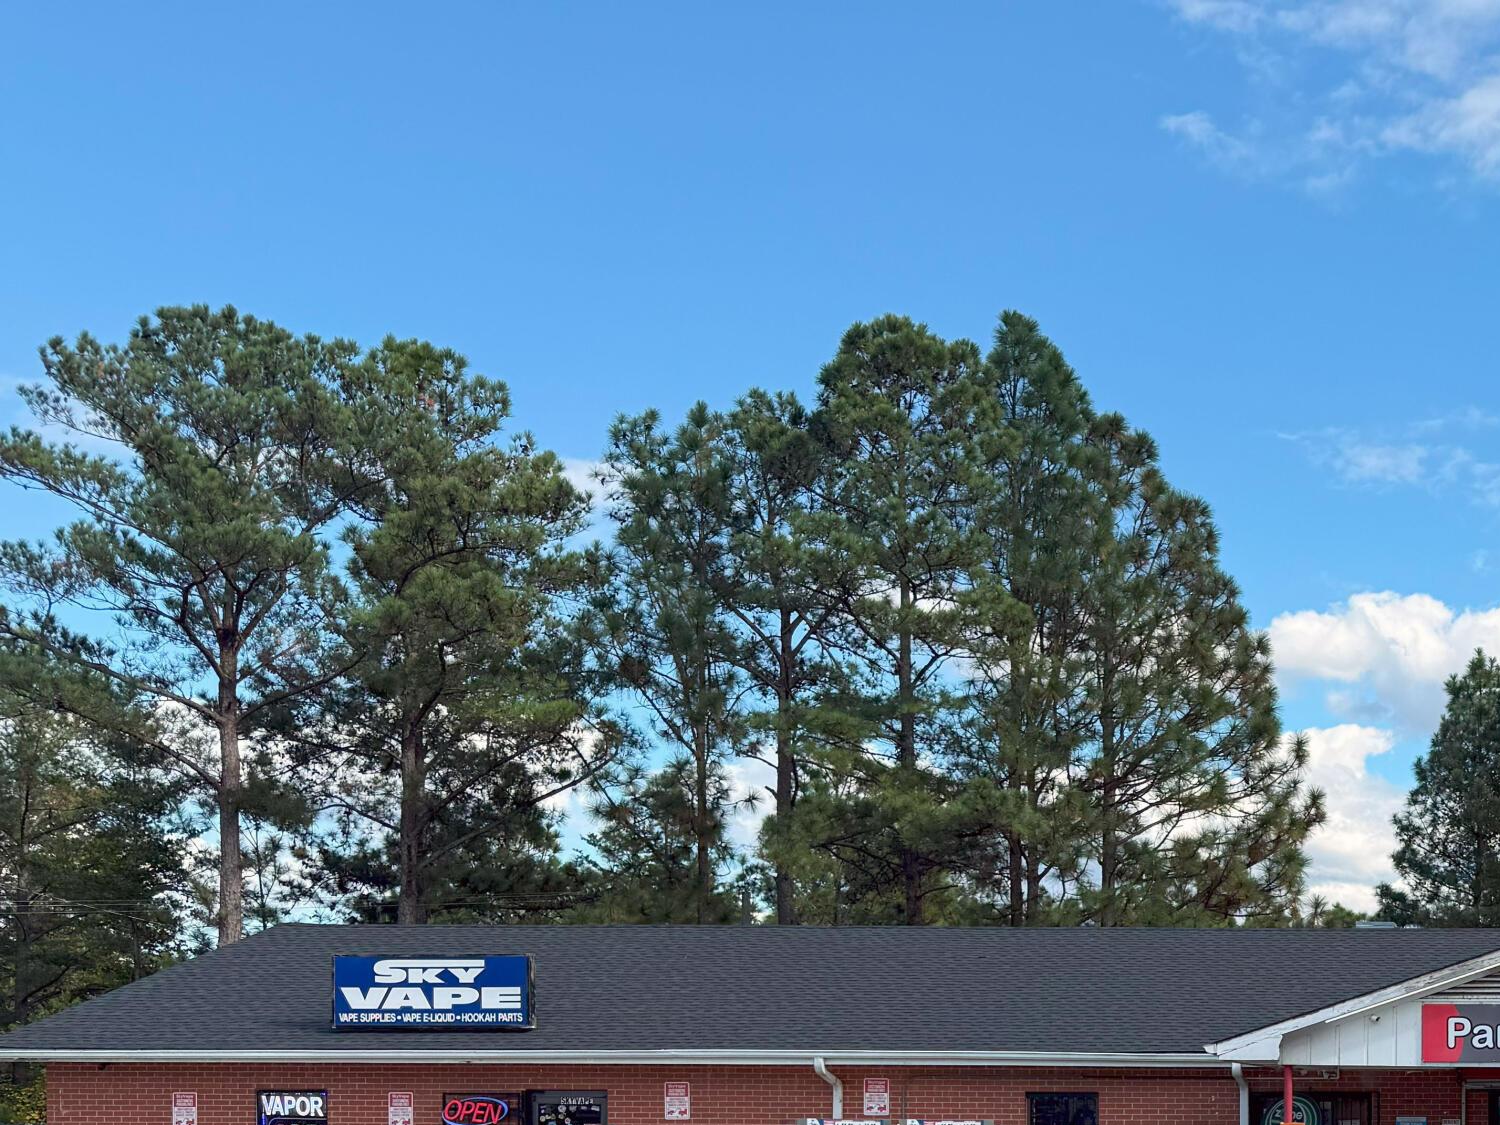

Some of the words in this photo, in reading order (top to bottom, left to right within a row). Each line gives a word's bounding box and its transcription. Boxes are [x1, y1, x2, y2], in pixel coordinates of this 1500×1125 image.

[373, 959, 485, 983] SKY
[340, 987, 521, 1010] VAPE
[339, 1012, 358, 1022] VAPE
[360, 1012, 396, 1022] SUPPLIES
[402, 1012, 422, 1022] VAPE
[423, 1012, 455, 1022] E-LIQUID
[461, 1012, 496, 1022] HOOKAH
[498, 1012, 522, 1022] PARTS
[261, 1095, 324, 1117] VAPOR
[444, 1100, 502, 1125] OPEN
[1275, 1109, 1304, 1120] zne
